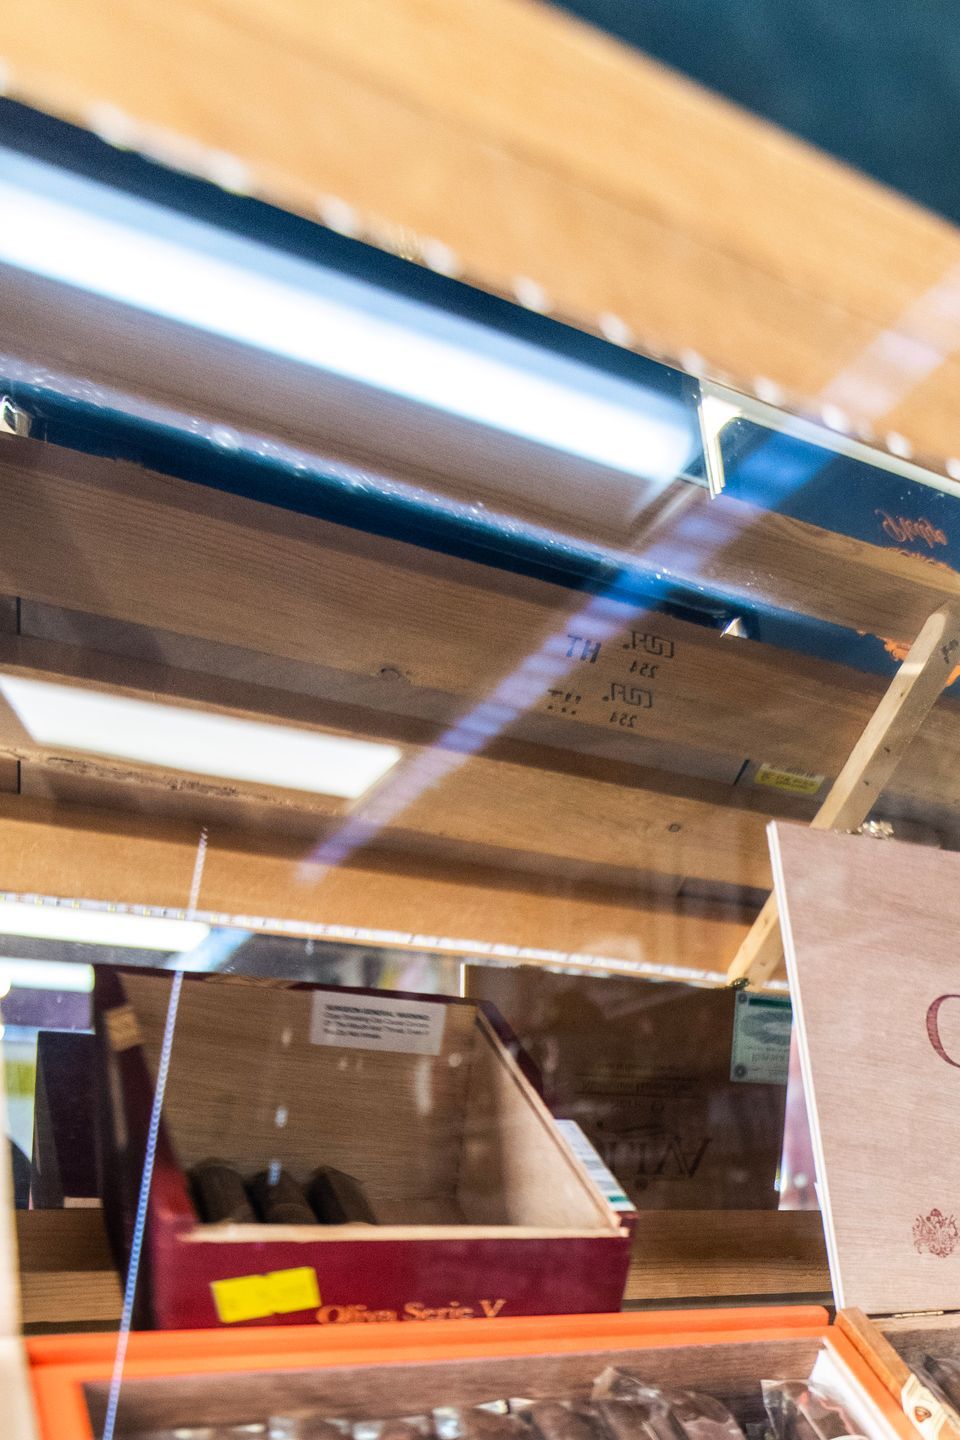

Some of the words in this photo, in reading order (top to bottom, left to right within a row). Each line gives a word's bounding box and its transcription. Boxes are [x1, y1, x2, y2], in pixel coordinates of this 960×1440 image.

[315, 1303, 398, 1325] Oliva
[403, 1301, 475, 1322] Serie
[479, 1298, 507, 1318] V
